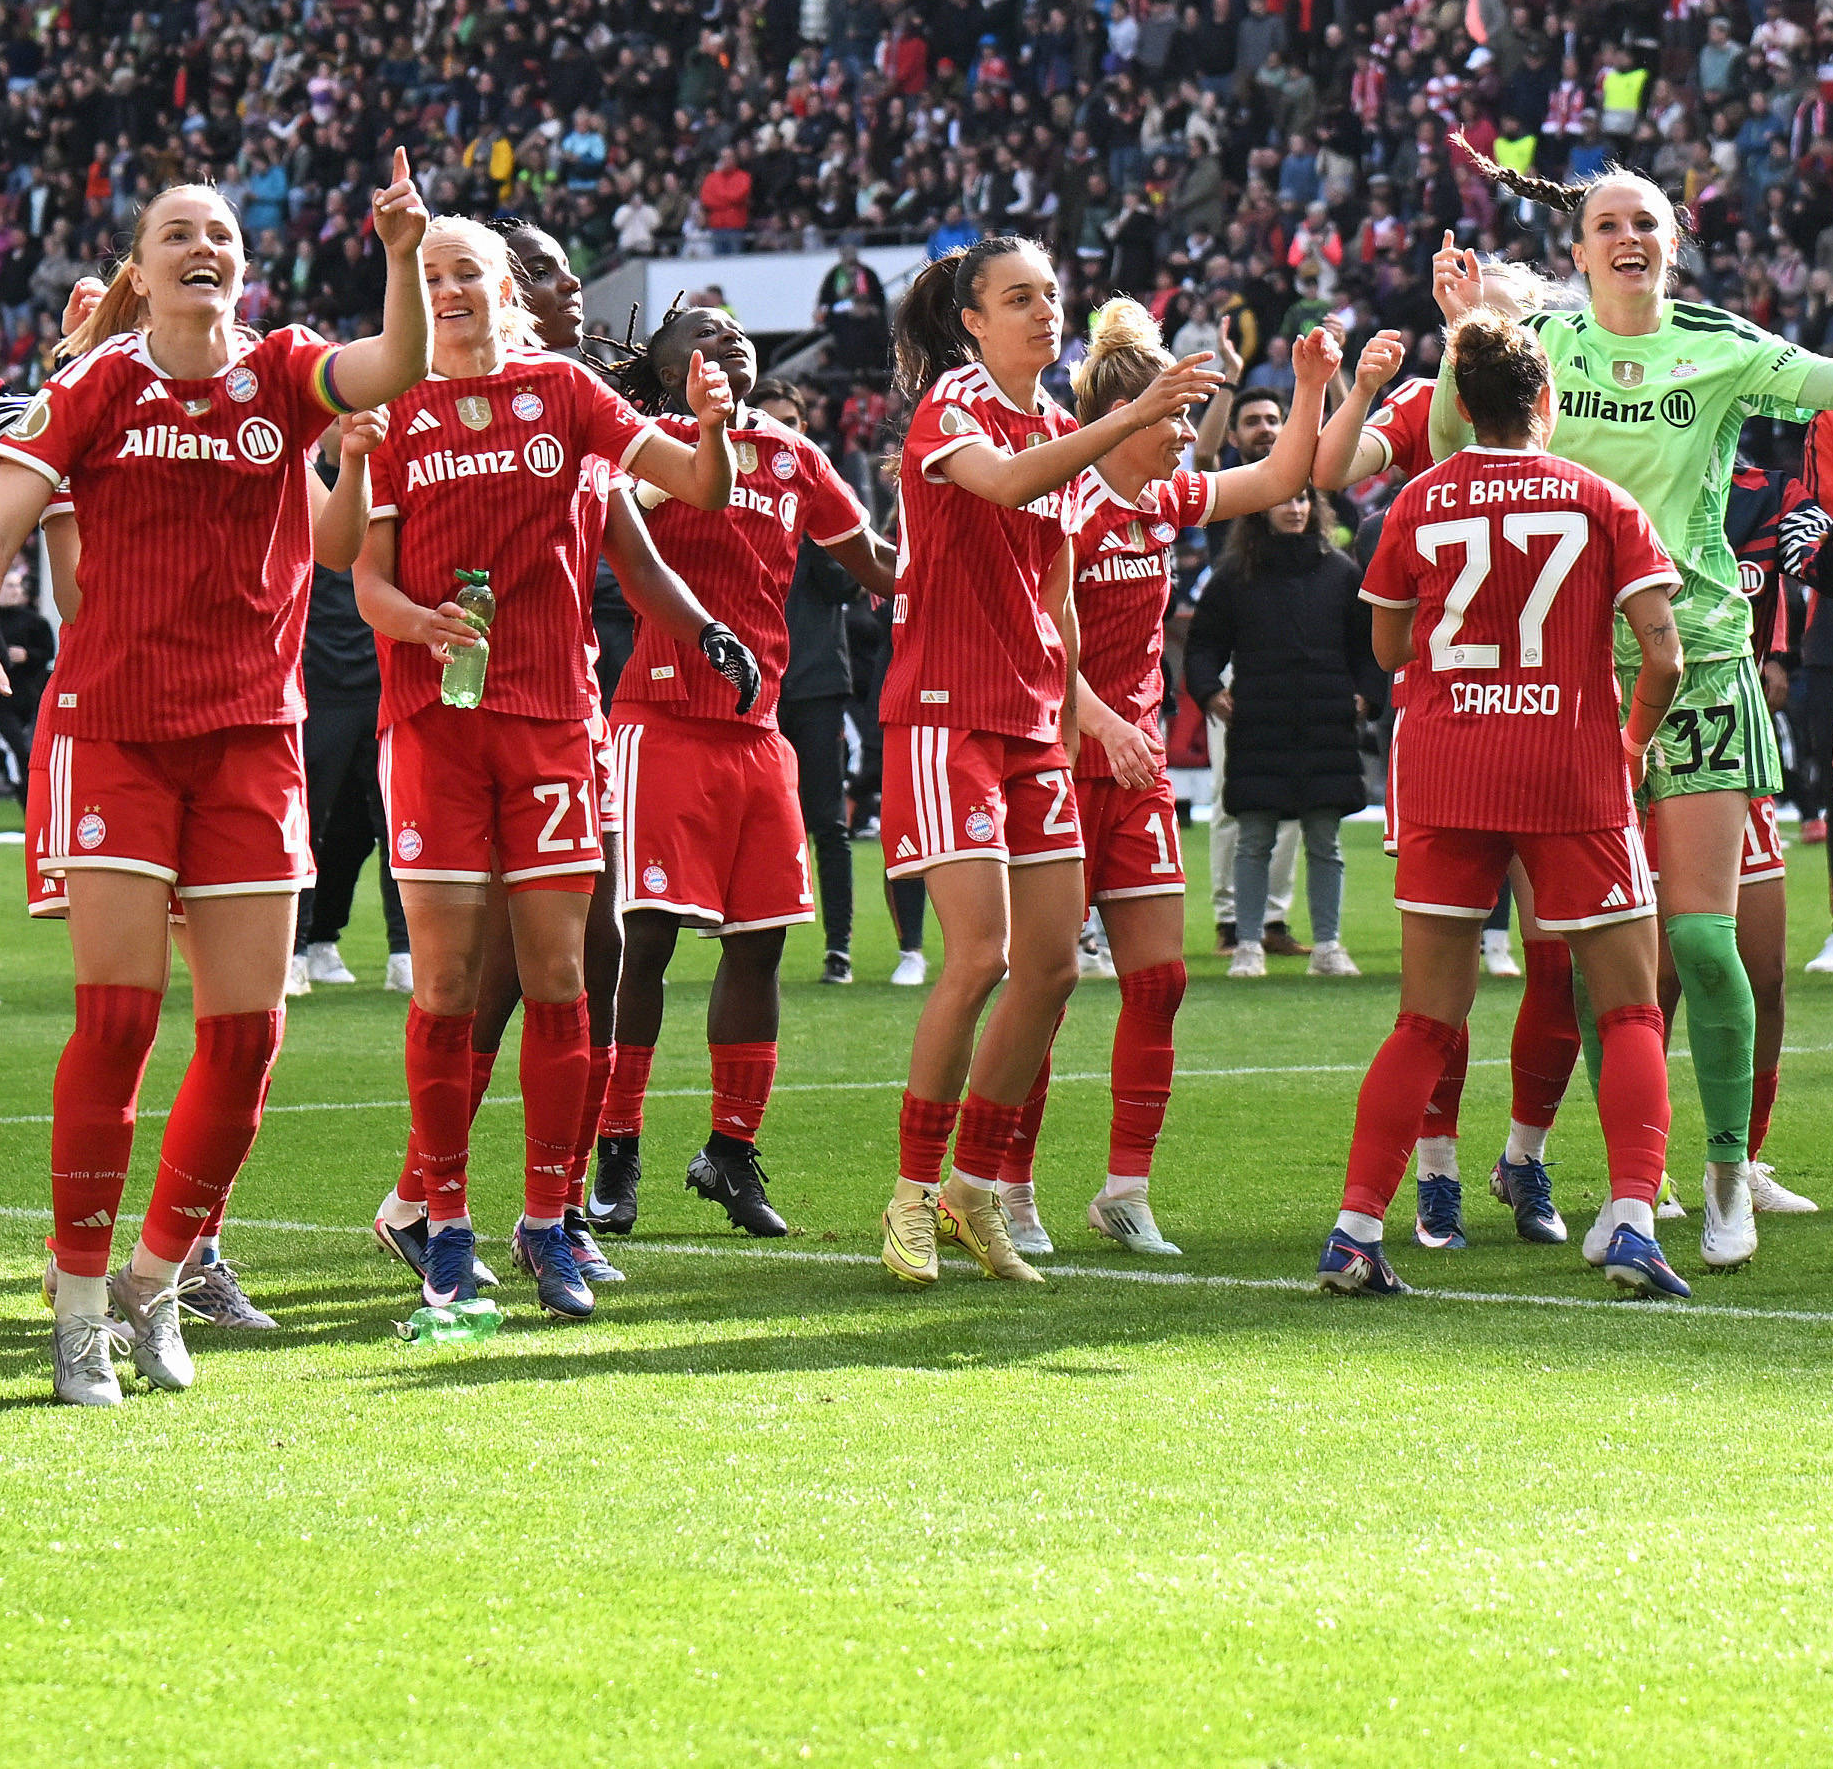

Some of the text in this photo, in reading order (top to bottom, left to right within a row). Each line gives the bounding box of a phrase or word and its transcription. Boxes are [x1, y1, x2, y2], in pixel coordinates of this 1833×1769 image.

[1557, 390, 1655, 423] Allianz
[119, 426, 235, 461] Allianz
[406, 447, 518, 492] Allianz
[1426, 477, 1579, 512] FC BAYERN
[1074, 553, 1163, 584] Allianz
[1416, 511, 1591, 670] 27
[1450, 682, 1560, 716] CARUSO
[1665, 704, 1741, 777] 32
[532, 779, 599, 853] 21
